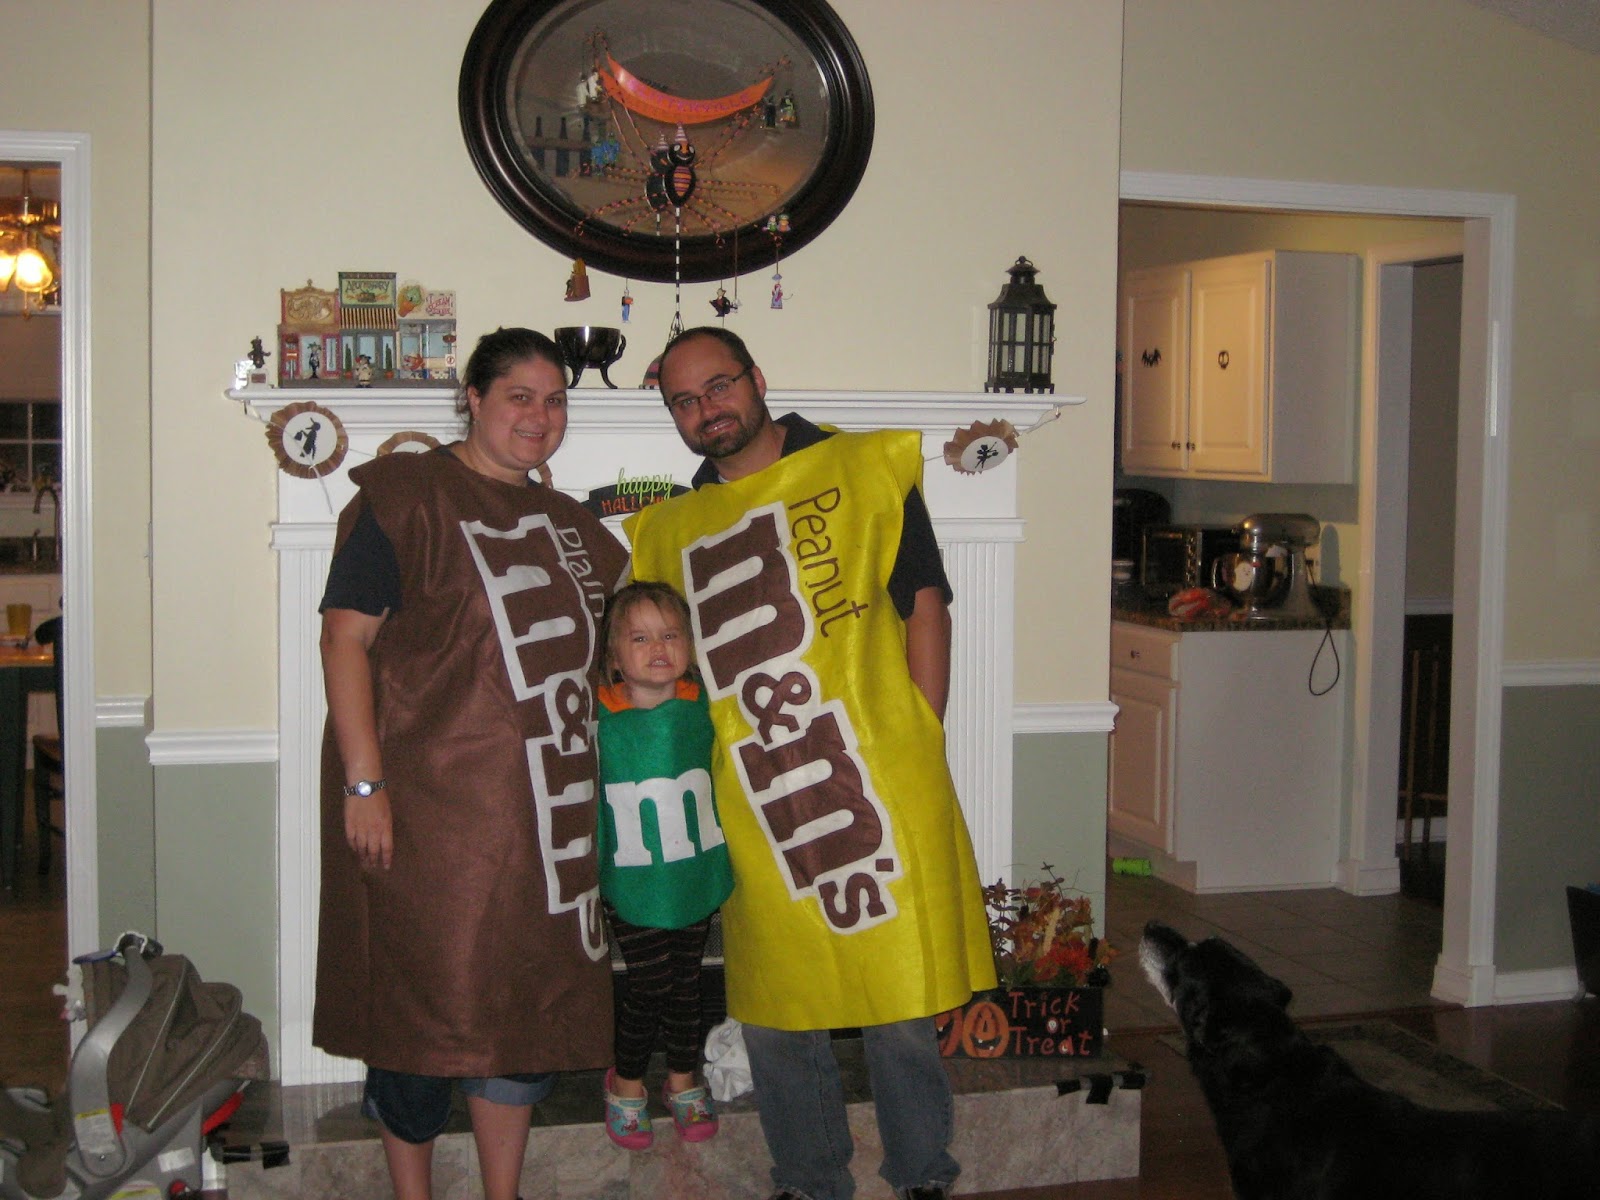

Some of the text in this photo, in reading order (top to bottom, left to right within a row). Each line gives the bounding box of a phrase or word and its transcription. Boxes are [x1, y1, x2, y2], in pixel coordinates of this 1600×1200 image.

[616, 467, 674, 503] happy
[788, 486, 869, 638] Peanut
[605, 768, 726, 867] m
[1008, 991, 1080, 1018] Trick
[1008, 1026, 1093, 1056] Treat
[1046, 1016, 1072, 1034] or
